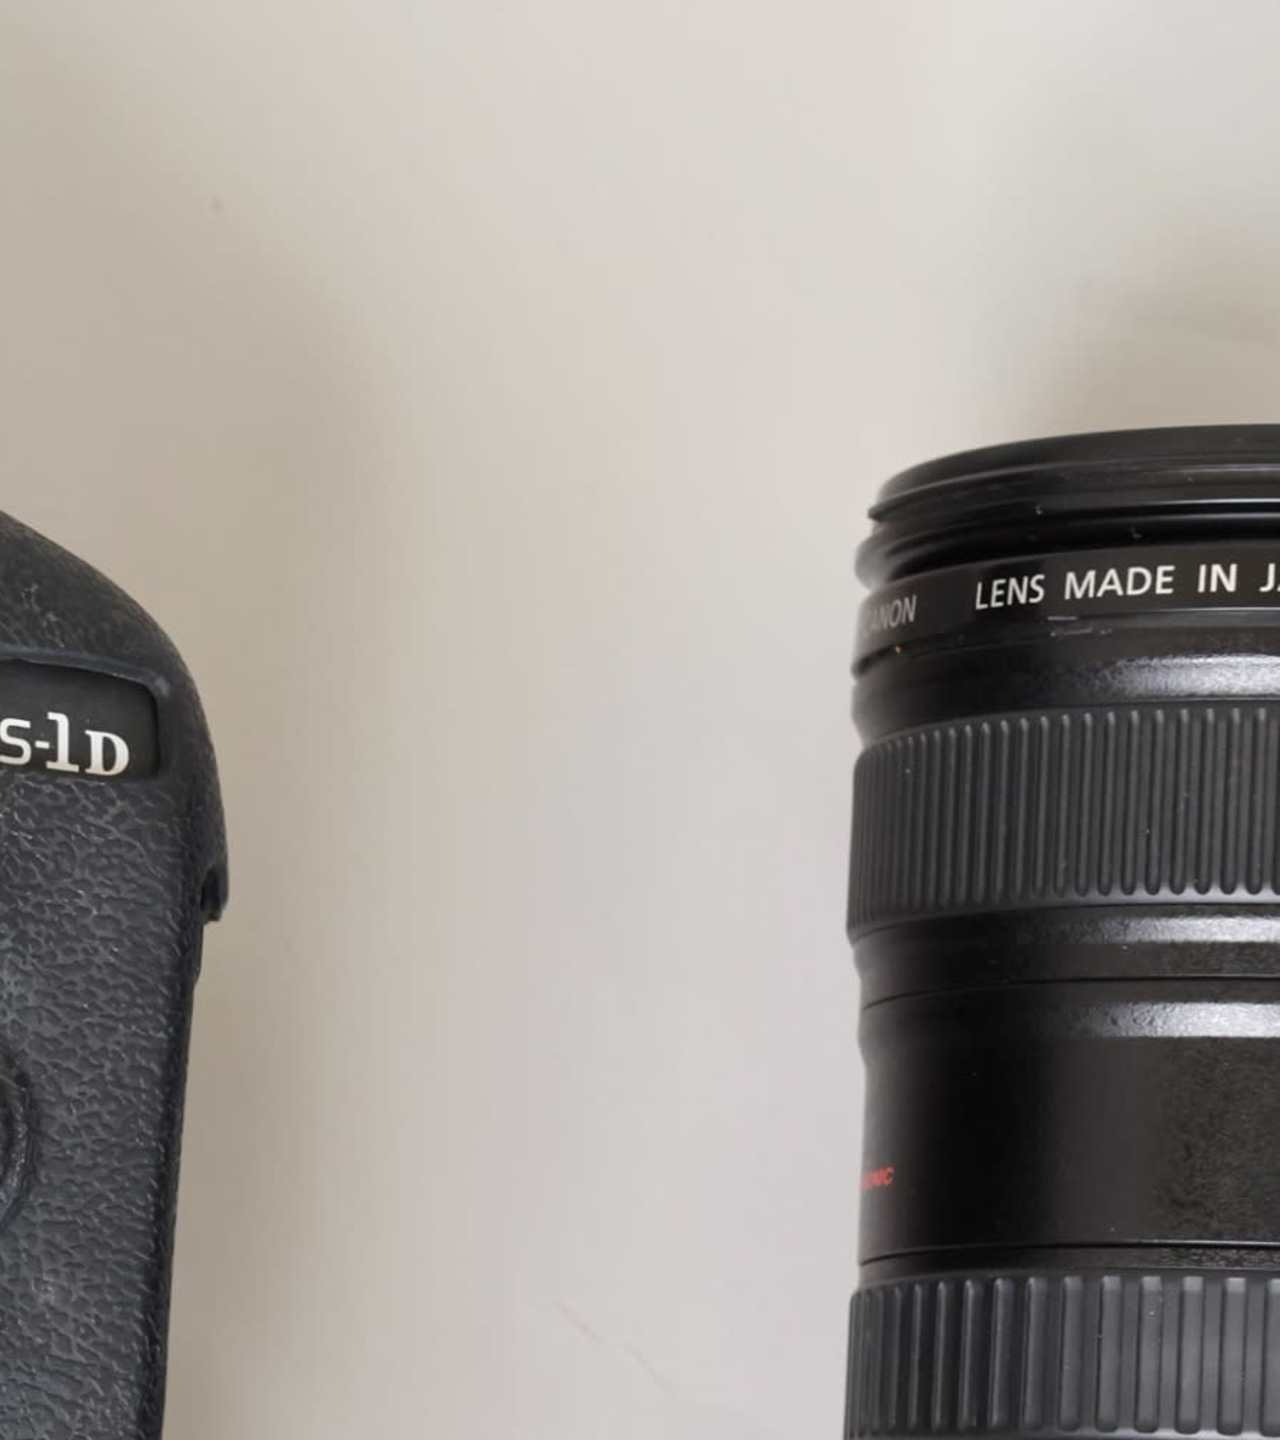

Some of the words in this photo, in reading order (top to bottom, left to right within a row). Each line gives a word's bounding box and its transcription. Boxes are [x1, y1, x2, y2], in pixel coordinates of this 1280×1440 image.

[975, 573, 1045, 610] LENS
[1064, 565, 1176, 601] MADE
[1196, 562, 1238, 593] IN
[1258, 562, 1280, 593] J
